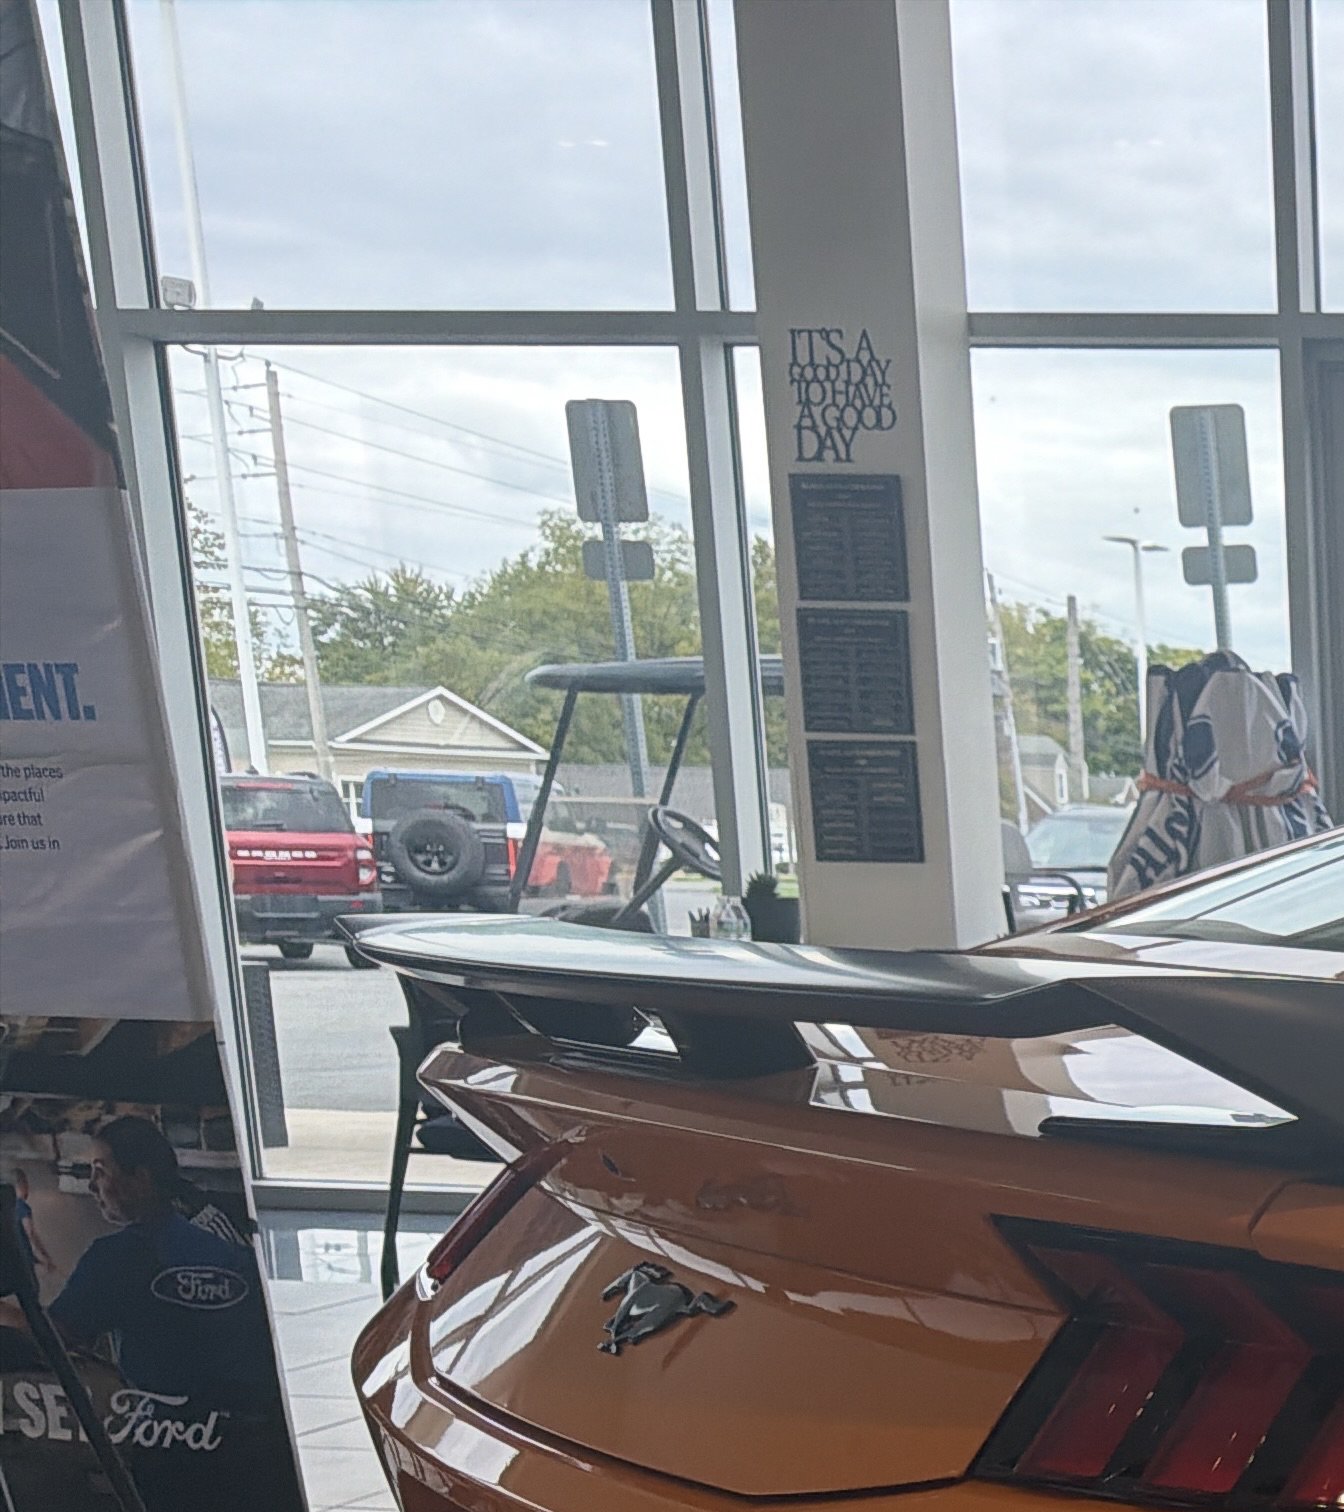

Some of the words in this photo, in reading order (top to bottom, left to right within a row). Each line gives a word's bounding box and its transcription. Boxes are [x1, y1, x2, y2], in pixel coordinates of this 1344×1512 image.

[855, 328, 875, 361] A
[789, 362, 840, 382] GOOD
[845, 359, 891, 387] DAY
[790, 379, 826, 406] TO
[832, 383, 891, 408] HAVE
[794, 401, 818, 430] A
[822, 402, 897, 431] GOOD
[796, 427, 854, 463] DAY
[0, 662, 97, 721] ENT.
[0, 763, 21, 778] the
[23, 764, 63, 780] places
[0, 787, 45, 804] pactful
[17, 812, 43, 826] that
[31, 839, 46, 850] us
[48, 836, 61, 850] in
[176, 1271, 232, 1300] Ford
[104, 1388, 223, 1451] Ford
